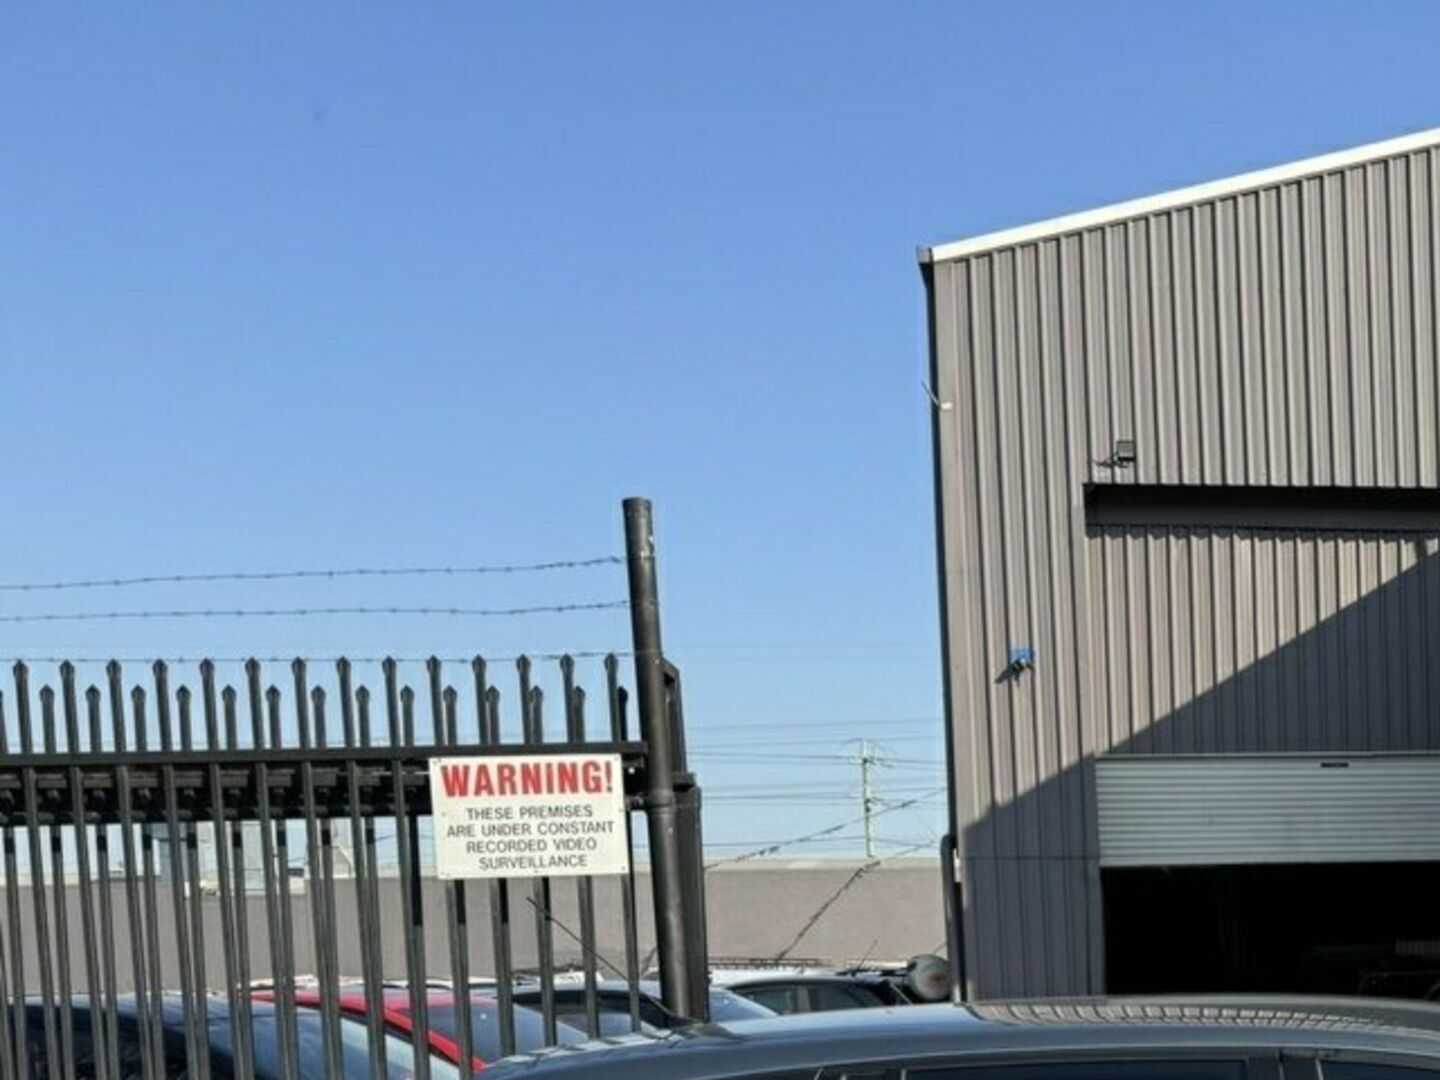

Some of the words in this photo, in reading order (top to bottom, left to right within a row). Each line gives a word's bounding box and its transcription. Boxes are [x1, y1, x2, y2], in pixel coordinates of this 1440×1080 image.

[440, 760, 614, 798] WARNING!
[466, 807, 514, 821] THESE
[519, 804, 593, 820] PREMISES
[447, 824, 476, 838] ARE
[481, 822, 532, 837] UNDER
[537, 820, 615, 836] CONSTANT
[466, 838, 548, 854] RECORDED
[552, 837, 598, 851] VIDEO
[478, 854, 588, 871] SURVEILLANCE
